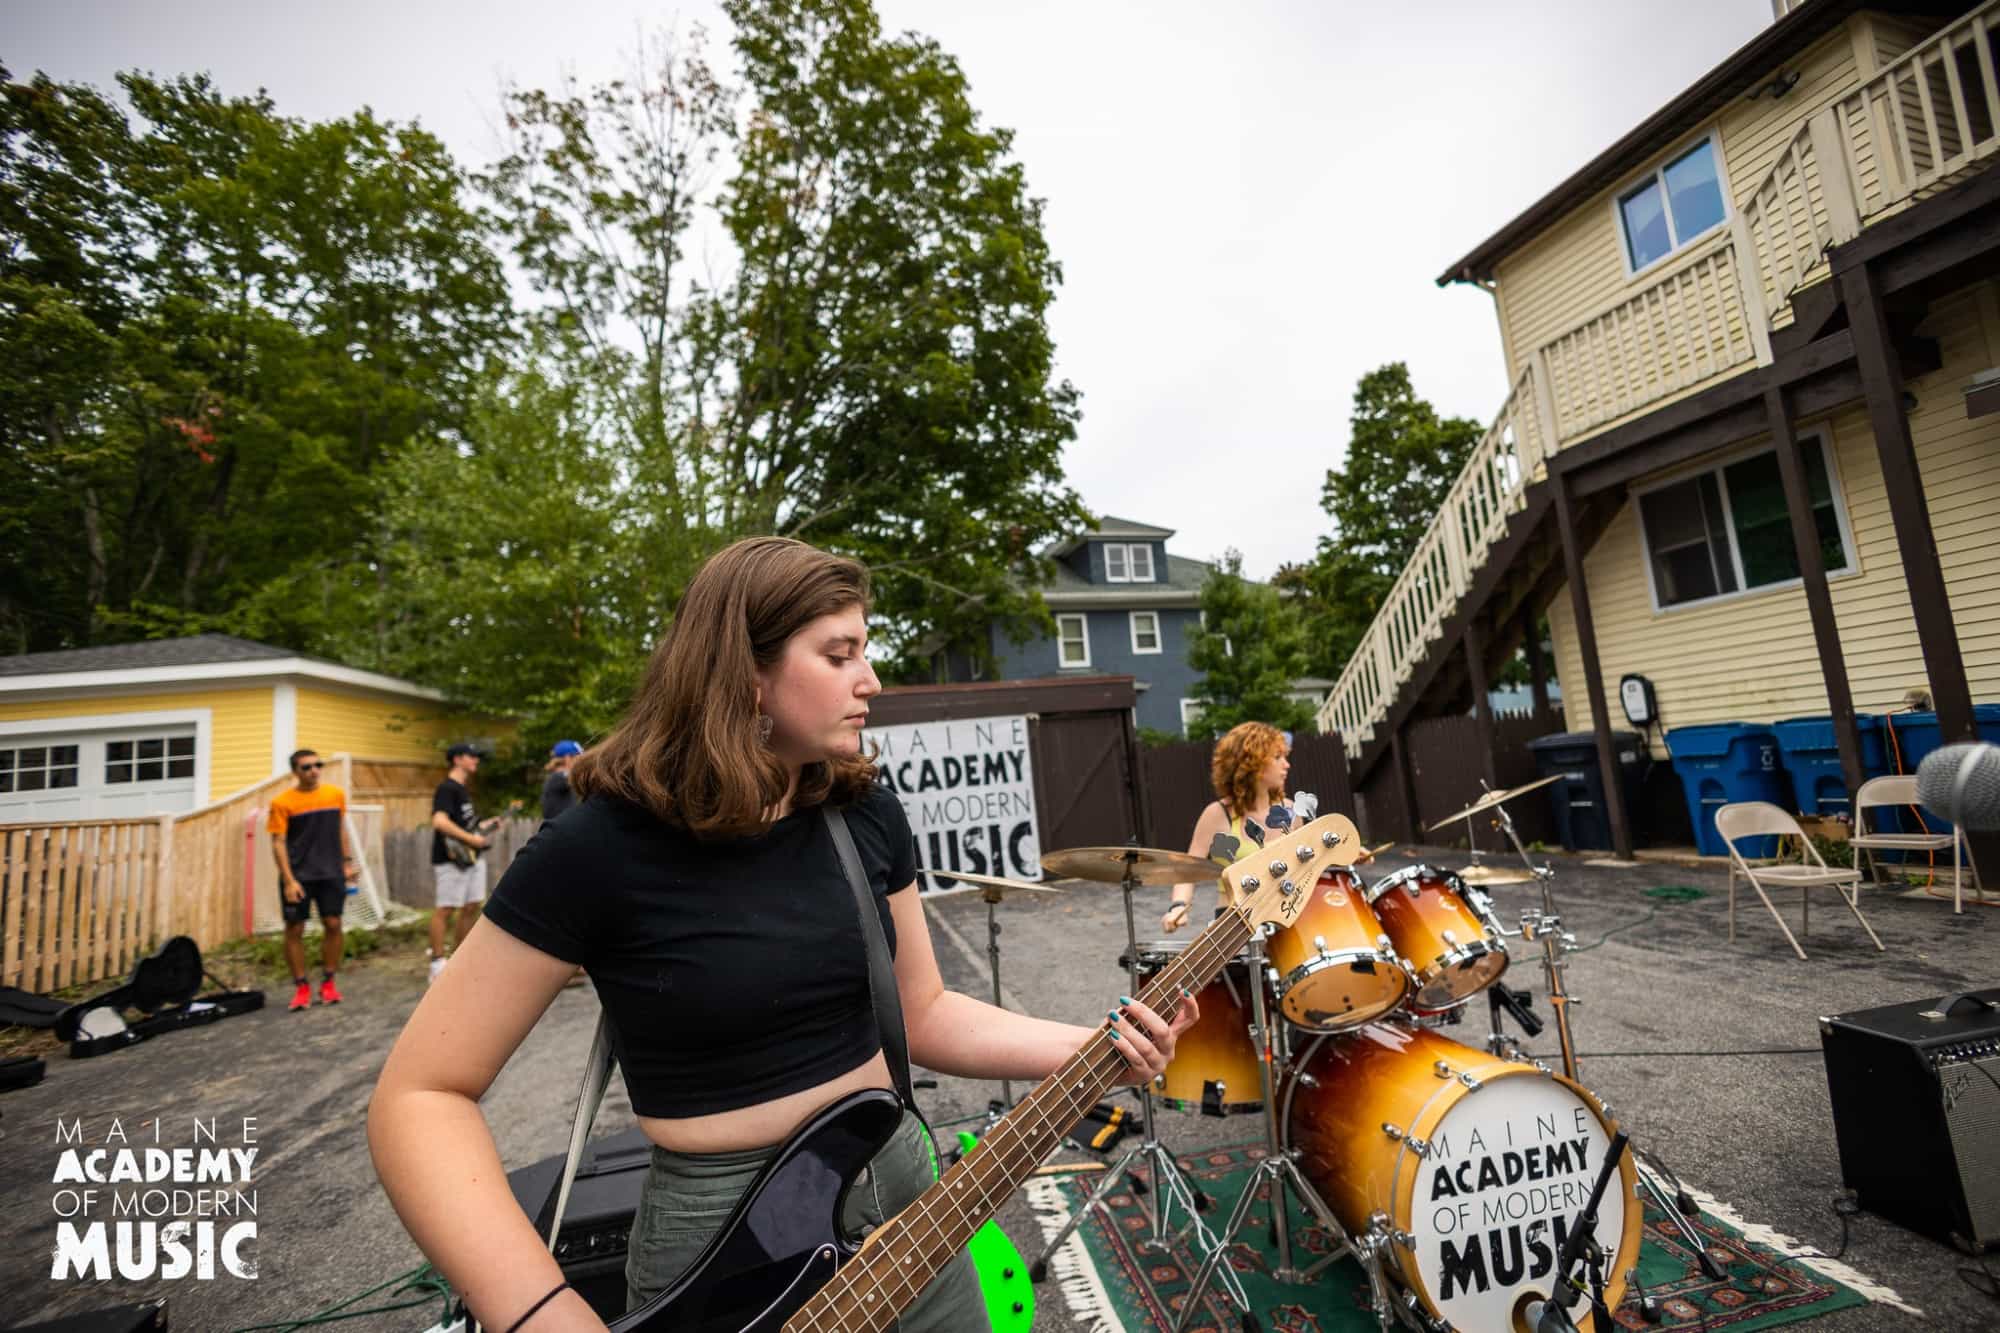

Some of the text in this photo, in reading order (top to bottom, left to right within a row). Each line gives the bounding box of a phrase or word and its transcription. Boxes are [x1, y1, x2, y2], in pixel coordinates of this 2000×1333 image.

[878, 749, 1026, 794] ACADEMY
[922, 789, 1032, 827] MODERN
[1428, 1107, 1588, 1161] MAINE
[1431, 1136, 1590, 1202] ACADEMY
[1433, 1176, 1596, 1235] OF MODERN
[1439, 1214, 1569, 1301] MUSI
